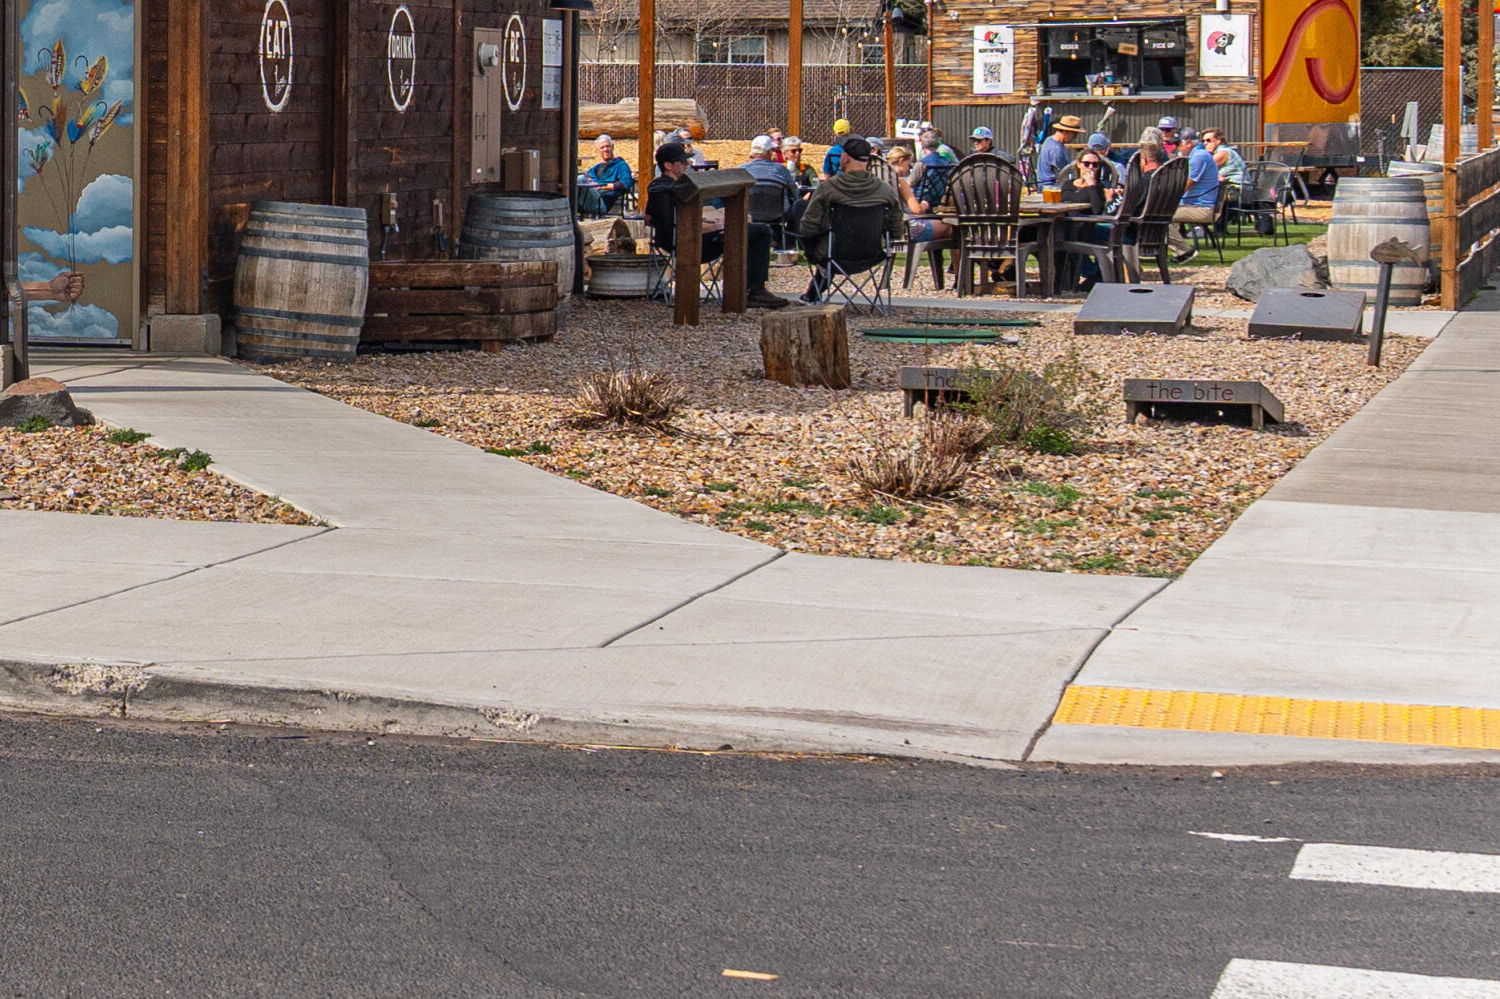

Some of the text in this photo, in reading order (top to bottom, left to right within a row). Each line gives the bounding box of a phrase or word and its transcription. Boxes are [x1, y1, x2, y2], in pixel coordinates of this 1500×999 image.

[266, 19, 287, 59] EAT
[392, 34, 413, 59] DRINK
[510, 30, 520, 63] BE
[1147, 381, 1234, 401] the bite
